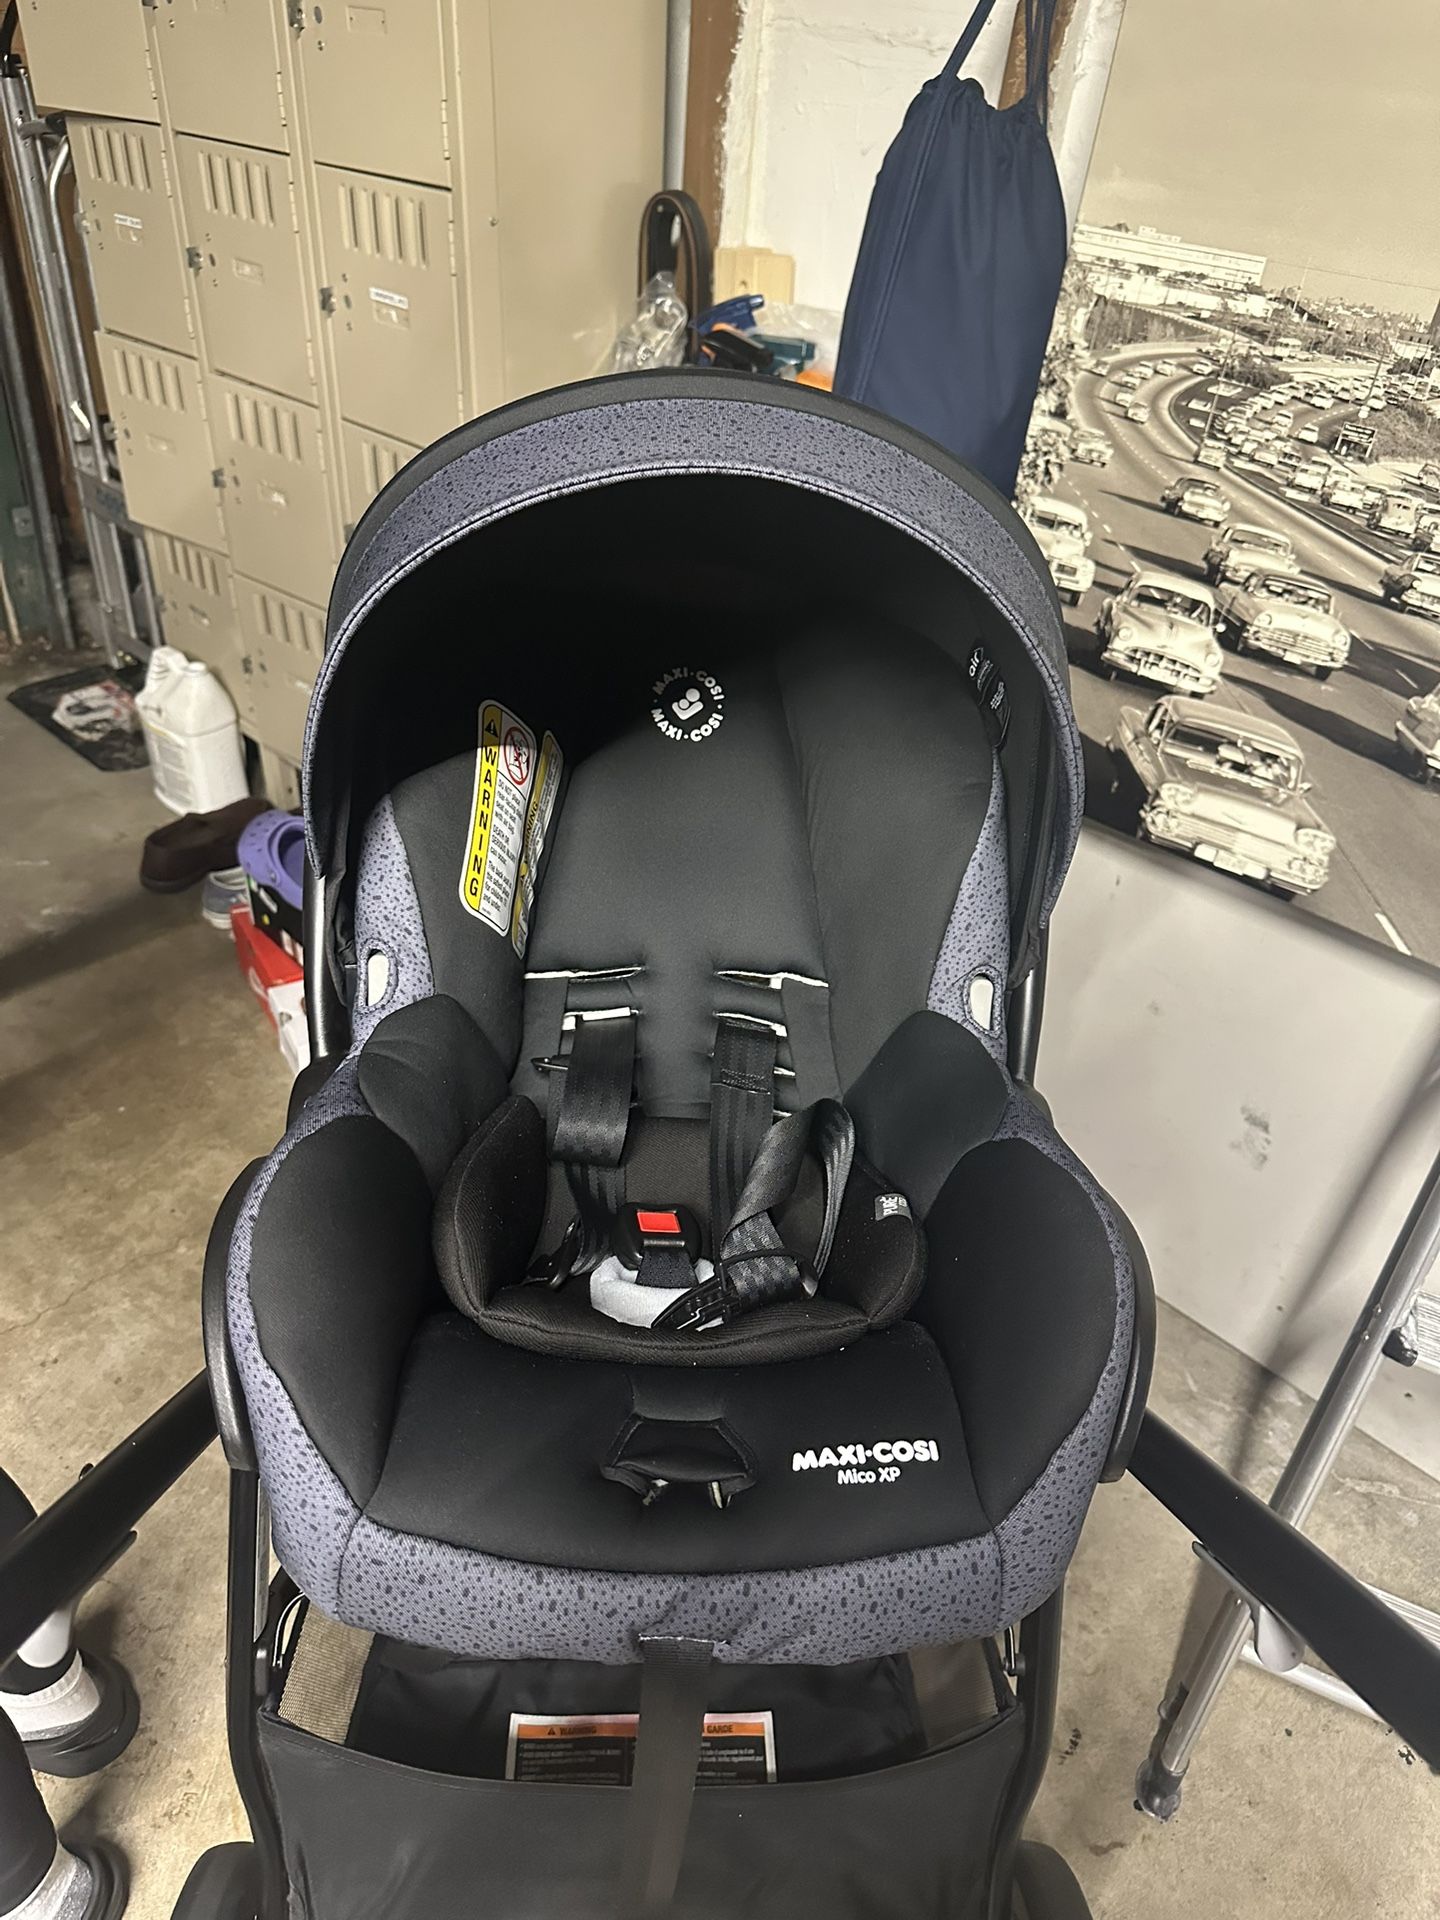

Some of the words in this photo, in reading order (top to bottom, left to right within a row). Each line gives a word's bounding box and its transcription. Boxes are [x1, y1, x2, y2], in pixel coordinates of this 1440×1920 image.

[969, 652, 980, 677] air
[469, 745, 497, 898] WARNING
[837, 1467, 877, 1485] Mico
[877, 1466, 901, 1483] XP
[707, 1724, 734, 1734] GARDE
